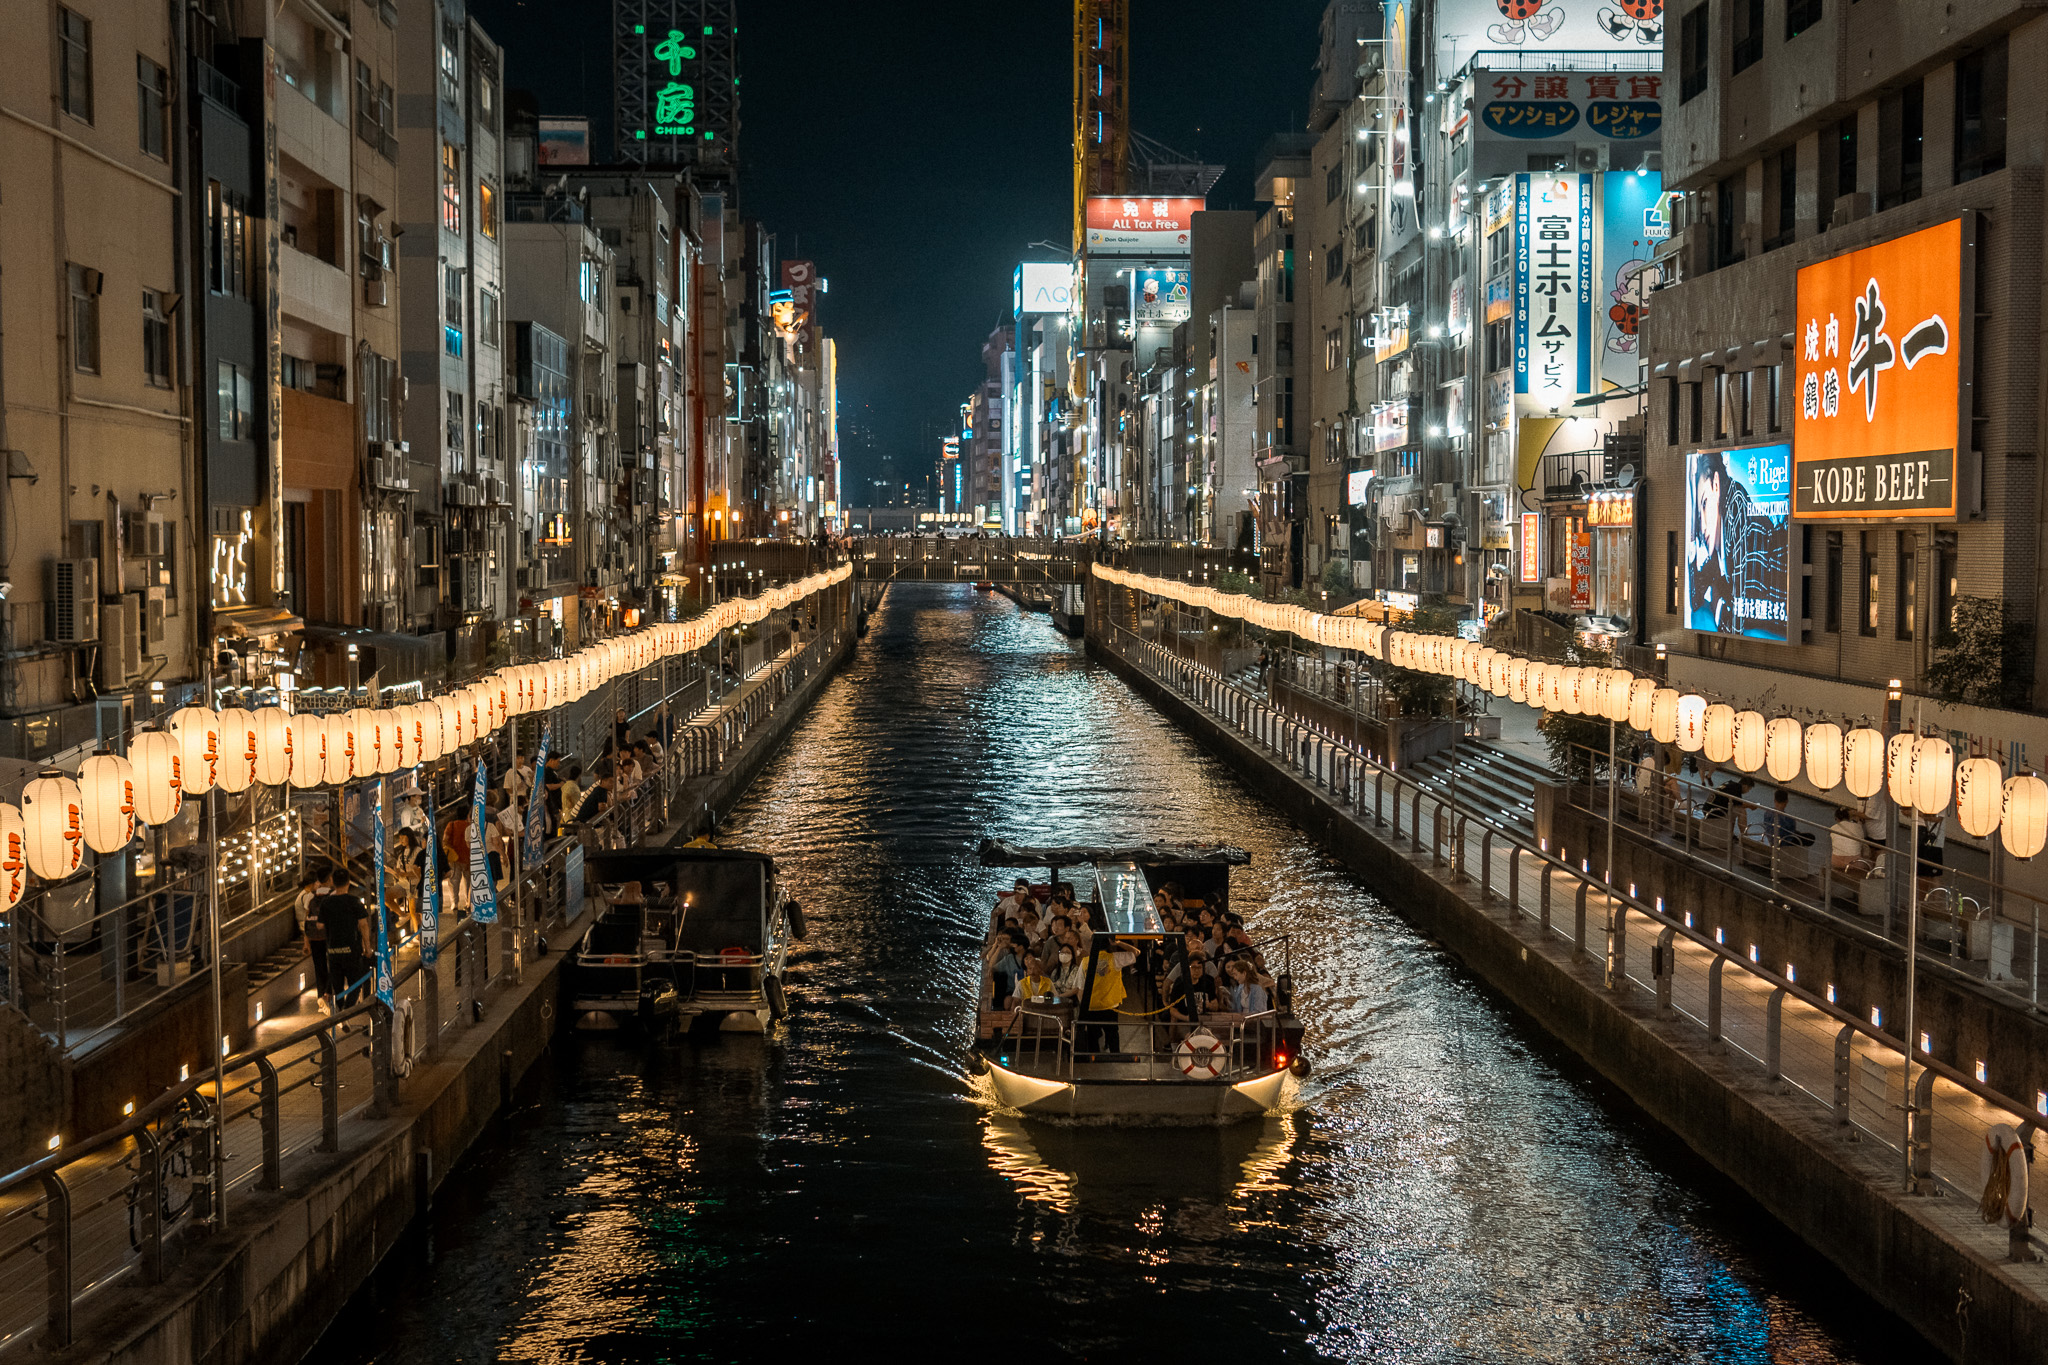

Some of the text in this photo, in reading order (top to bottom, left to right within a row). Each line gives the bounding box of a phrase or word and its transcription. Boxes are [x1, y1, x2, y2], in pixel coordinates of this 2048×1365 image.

[654, 29, 696, 124] 千房
[1492, 76, 1662, 99] 分譲 賃貸
[1489, 106, 1575, 126] マンション
[1593, 105, 1662, 125] レジャー
[655, 126, 695, 135] CHIBO
[1610, 126, 1641, 137] ビル
[1123, 200, 1169, 217] 免税
[1112, 219, 1179, 229] ALL Tax Free
[1535, 214, 1572, 388] 富士ホームサービス
[1804, 312, 1839, 362] 焼肉
[1847, 277, 1949, 423] 牛一
[1759, 456, 1789, 491] Rigel
[1812, 460, 1930, 504] KOBE BEEF
